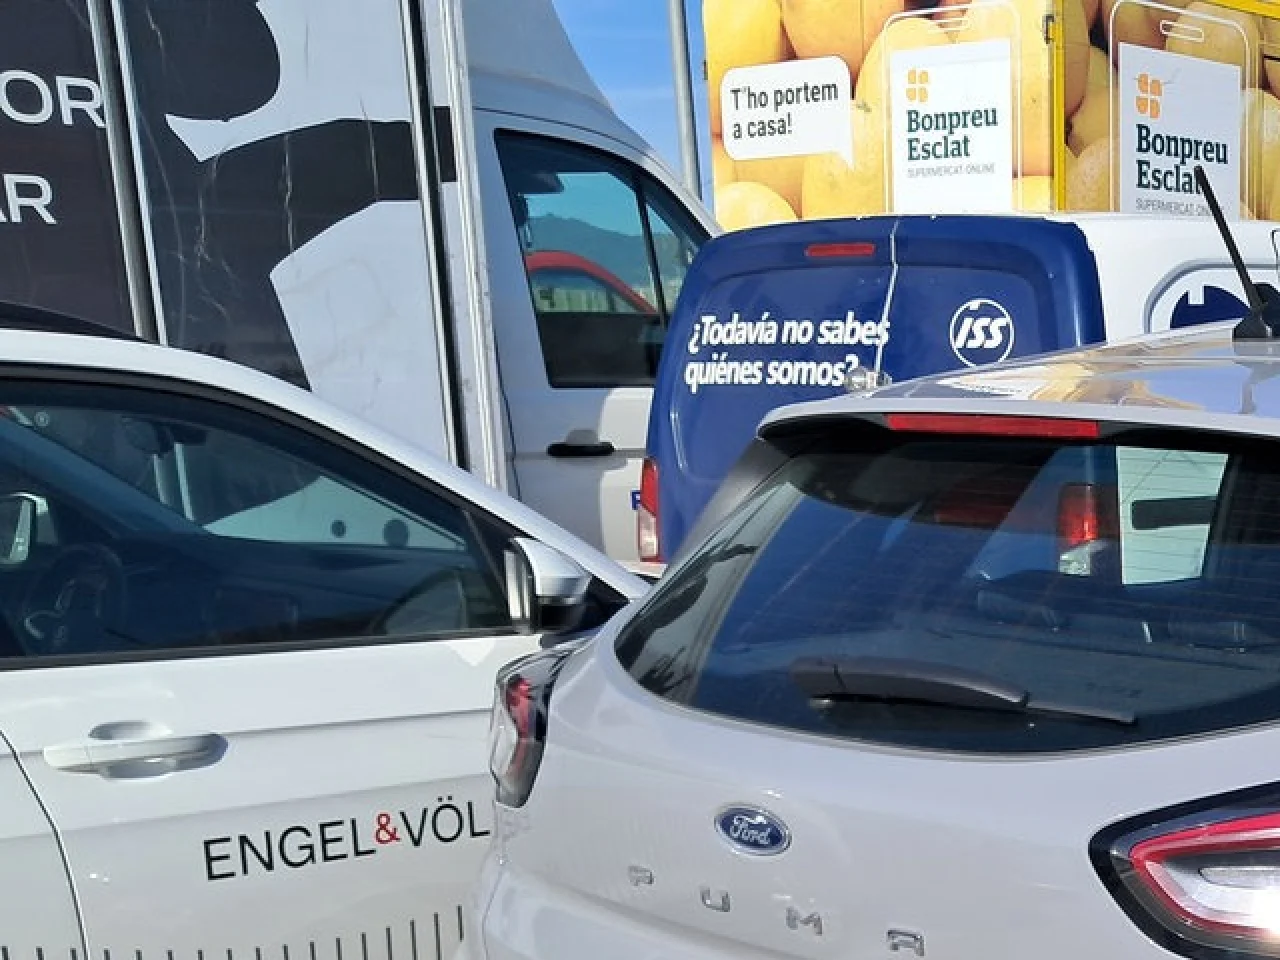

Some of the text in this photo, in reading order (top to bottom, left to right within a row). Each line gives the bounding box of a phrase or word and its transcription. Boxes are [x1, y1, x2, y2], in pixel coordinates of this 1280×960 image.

[729, 82, 839, 113] T'ho portem
[732, 112, 793, 139] a casa!
[906, 107, 999, 136] Bonpreu
[906, 133, 971, 162] Esclat
[1136, 123, 1229, 165] Bonpreu
[0, 173, 57, 225] R
[687, 311, 890, 354] ¿Todavía no sabes
[685, 351, 860, 395] quiénes somos?
[729, 815, 772, 845] Ford
[627, 865, 926, 958] PUMA
